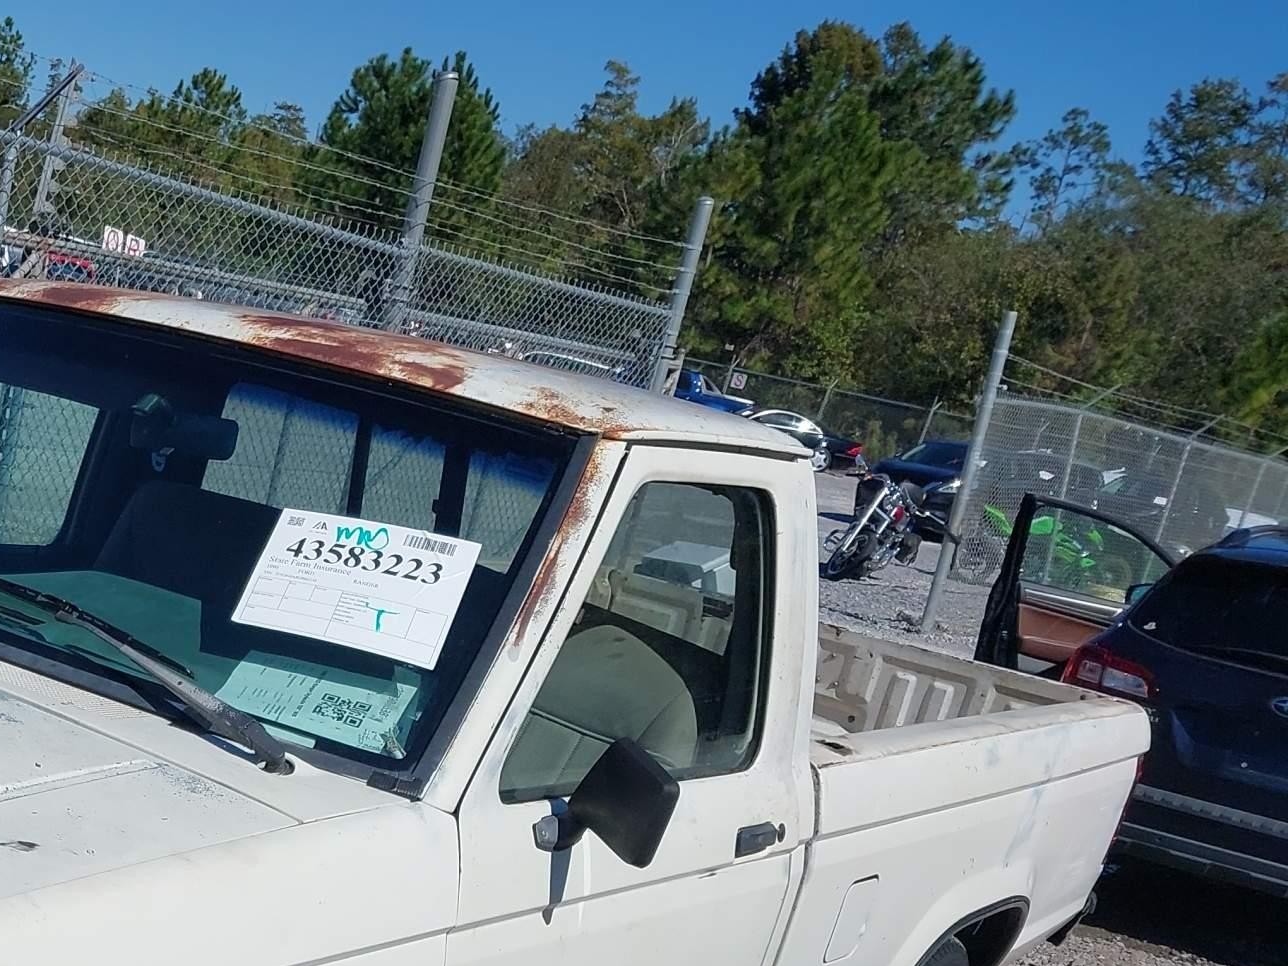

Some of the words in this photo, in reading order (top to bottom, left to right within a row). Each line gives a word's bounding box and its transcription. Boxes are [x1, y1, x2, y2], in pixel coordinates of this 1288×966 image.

[268, 555, 289, 566] State
[291, 559, 311, 569] Farm
[313, 561, 352, 576] Insurance
[286, 537, 444, 584] 43583223
